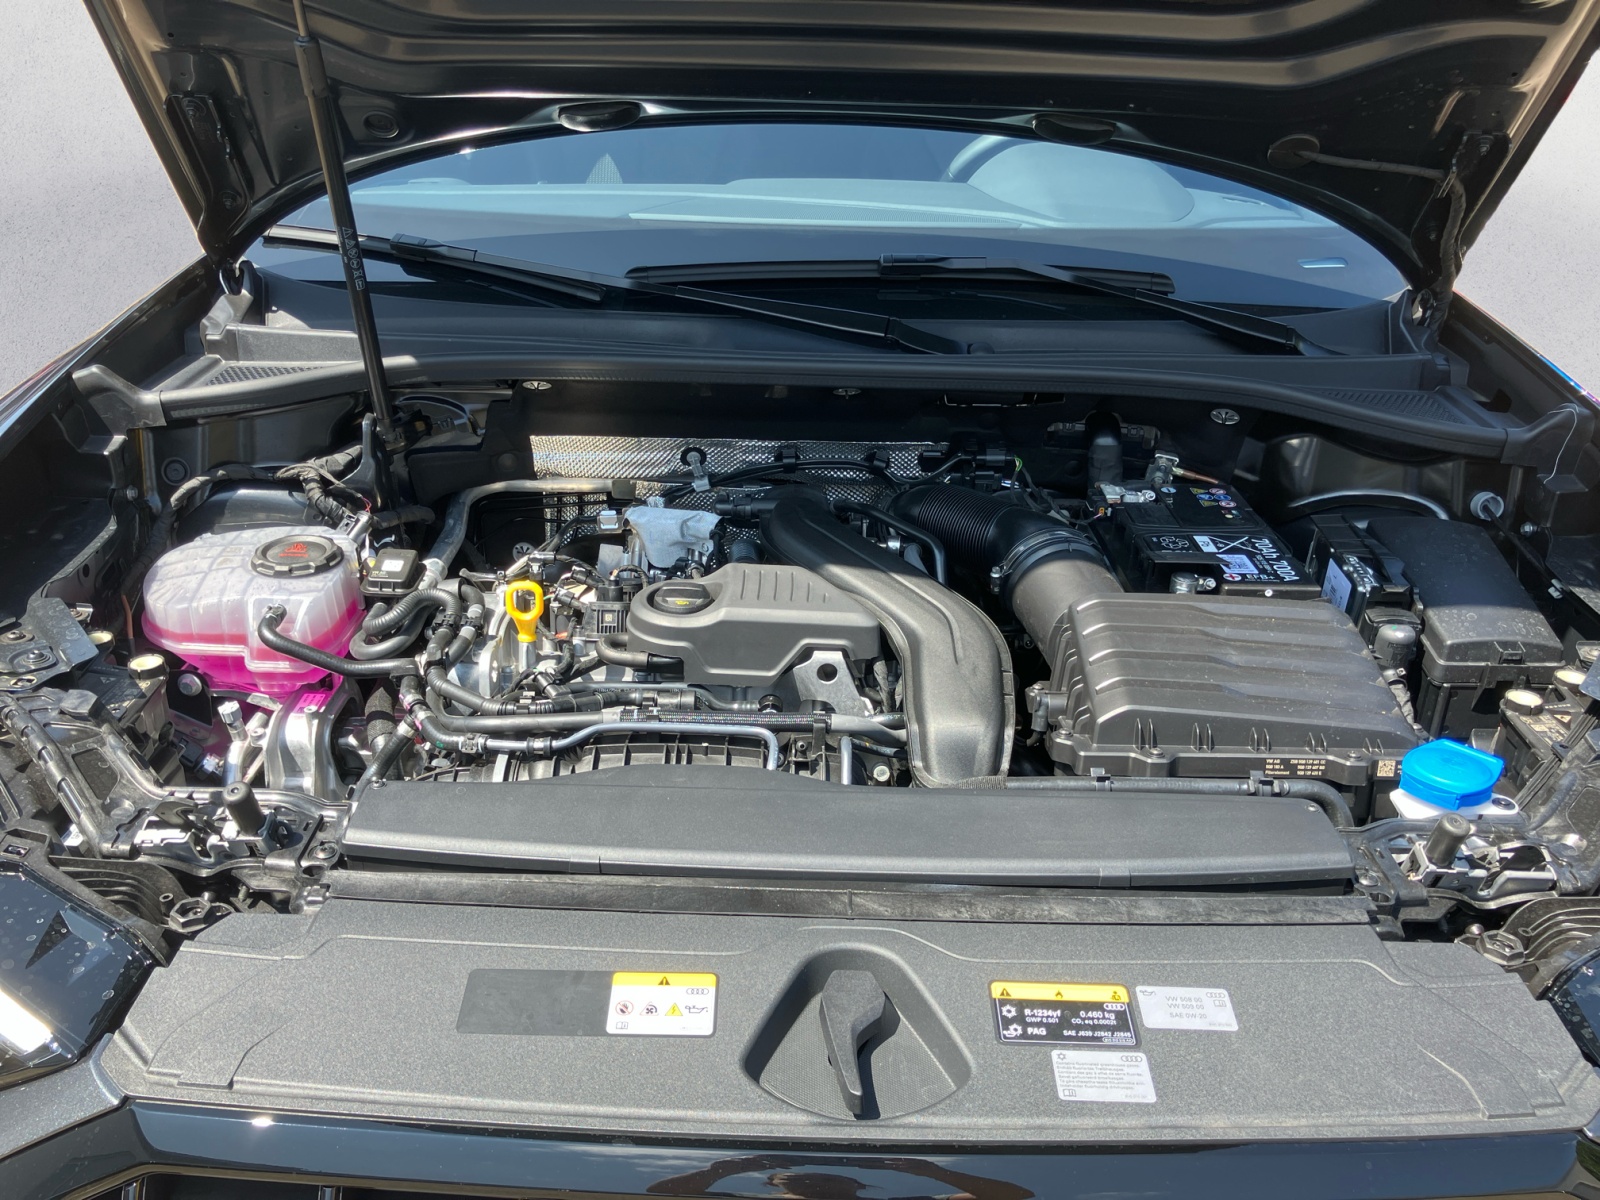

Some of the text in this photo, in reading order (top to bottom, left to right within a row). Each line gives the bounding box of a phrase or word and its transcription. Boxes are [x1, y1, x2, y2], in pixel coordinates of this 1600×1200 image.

[1251, 538, 1280, 558] 70Ah
[1268, 560, 1300, 581] 700A
[1024, 1009, 1061, 1018] R-1234yf
[1104, 1011, 1115, 1019] kg
